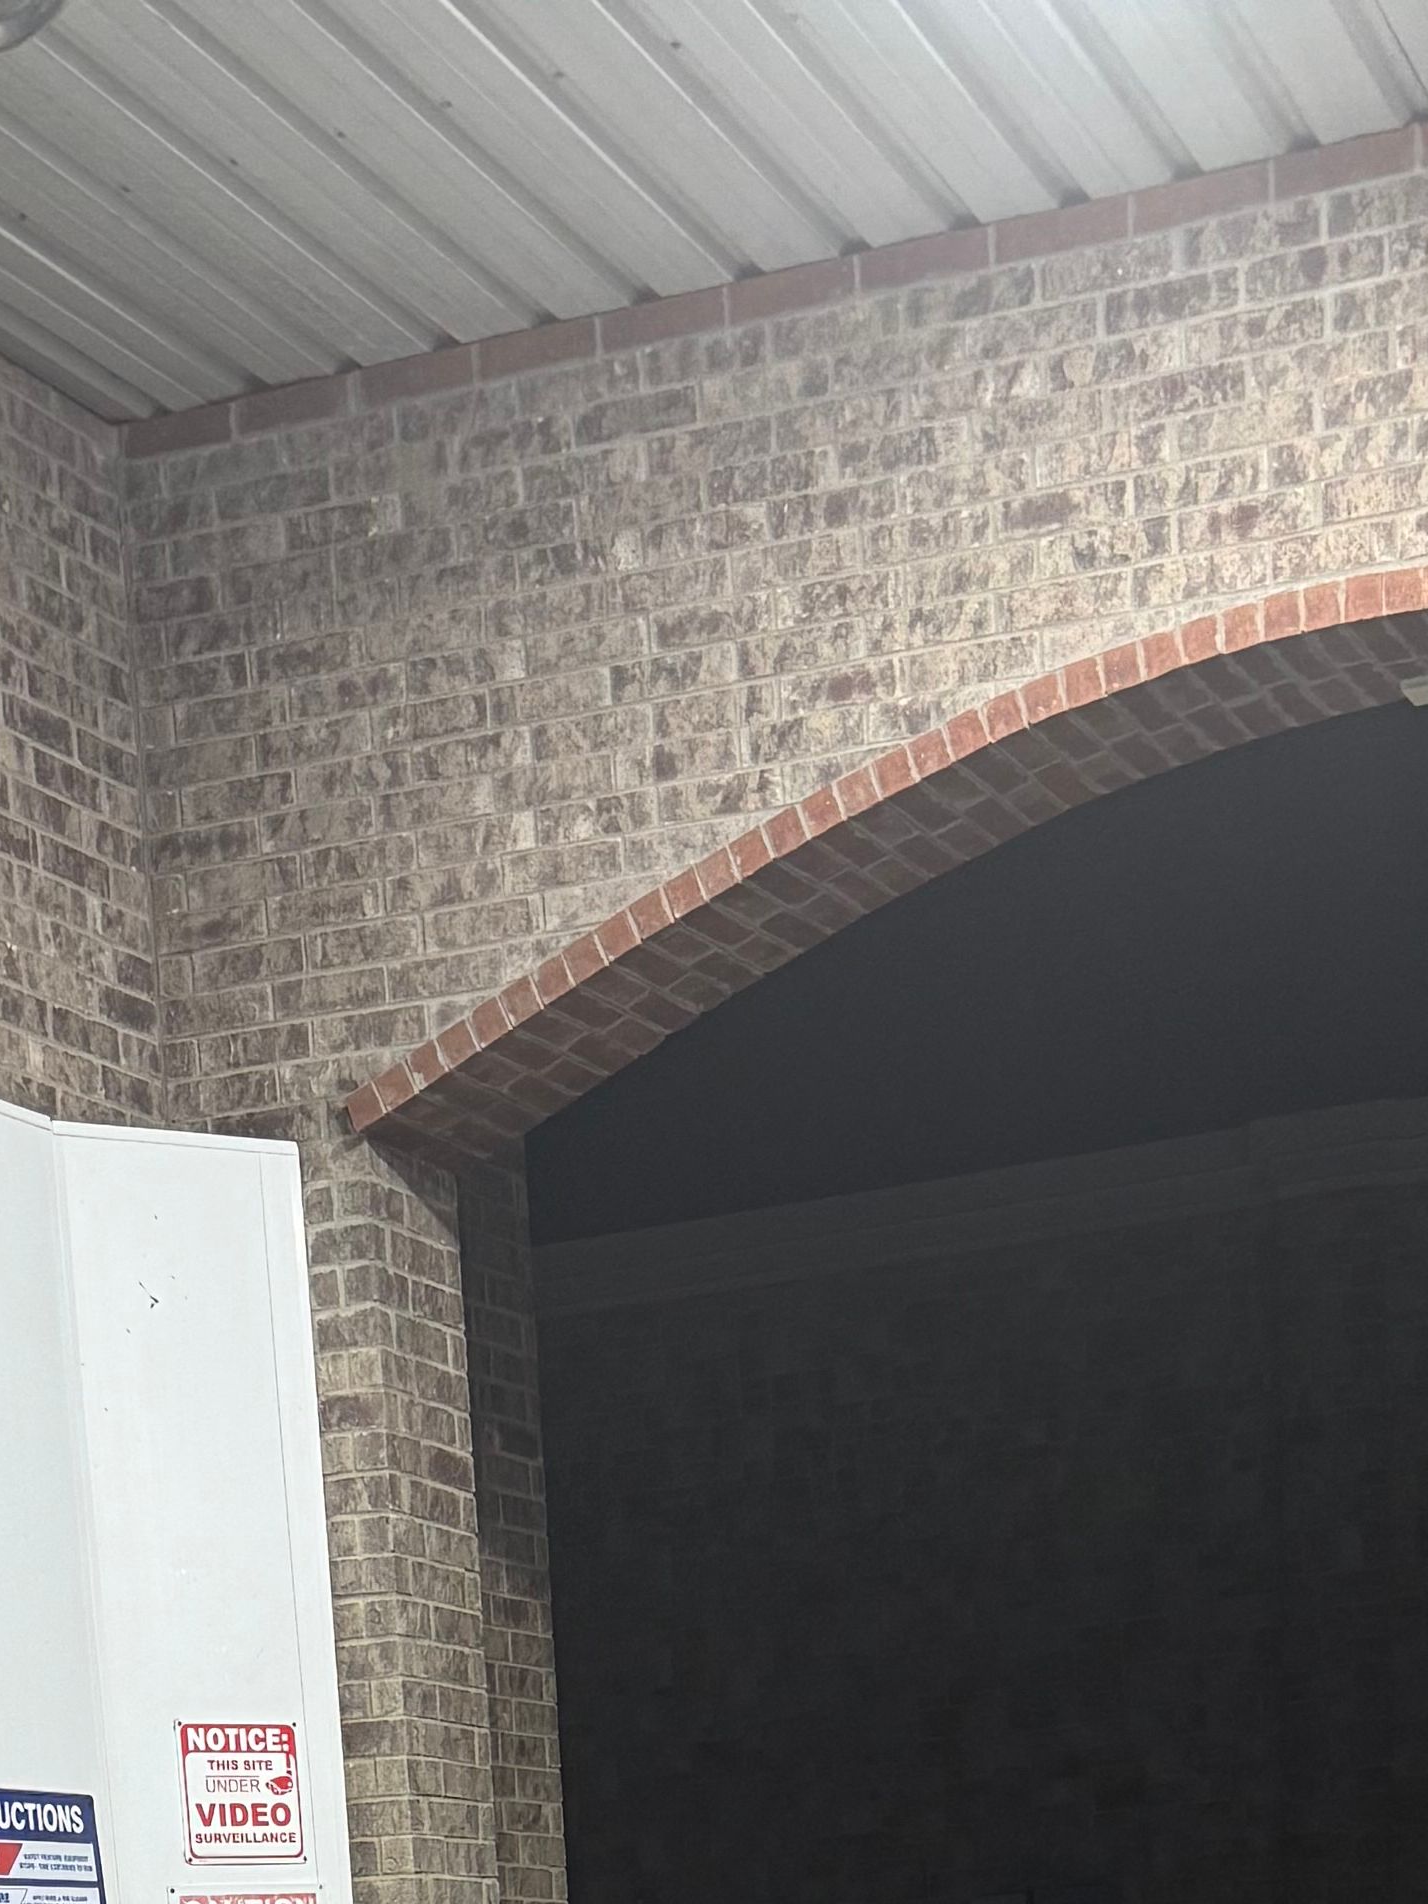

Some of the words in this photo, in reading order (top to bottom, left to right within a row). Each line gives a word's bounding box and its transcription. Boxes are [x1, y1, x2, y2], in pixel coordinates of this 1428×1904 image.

[186, 1728, 290, 1751] NOTICE:
[207, 1760, 238, 1770] THIS
[244, 1760, 273, 1770] SITE
[205, 1779, 261, 1793] UNDER
[195, 1803, 291, 1827] VIDEO
[195, 1833, 296, 1843] SURVEILLANCE
